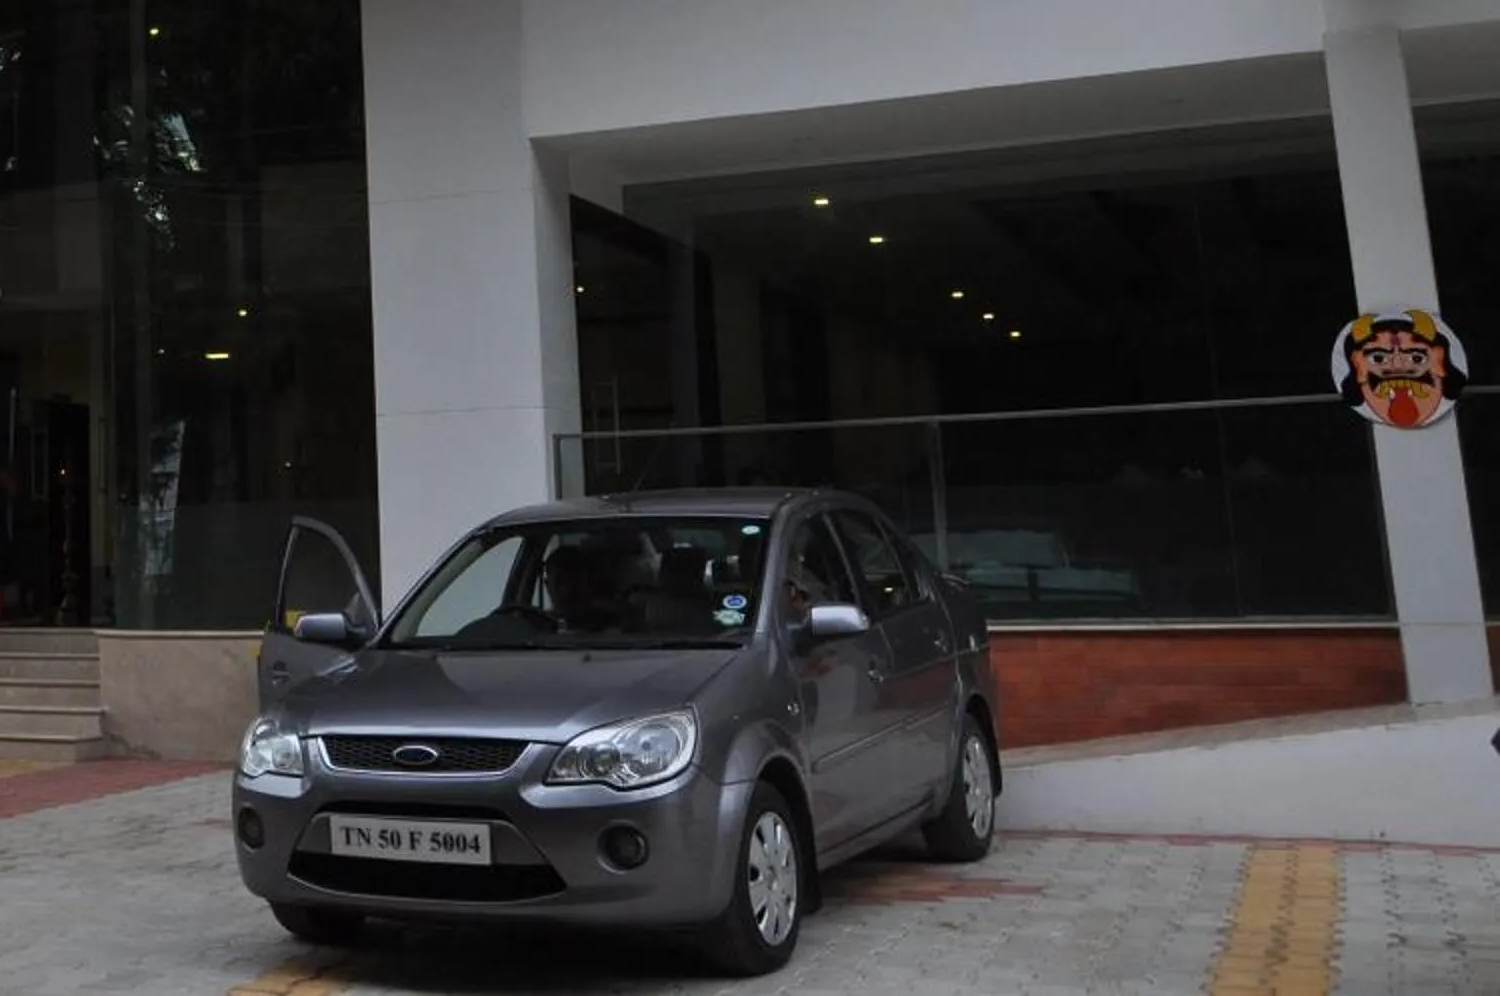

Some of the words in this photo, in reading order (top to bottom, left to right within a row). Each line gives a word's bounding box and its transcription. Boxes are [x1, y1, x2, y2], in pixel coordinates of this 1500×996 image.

[340, 826, 371, 846] TN
[377, 829, 401, 850] 50
[408, 831, 423, 851] F
[429, 832, 480, 853] 5004
